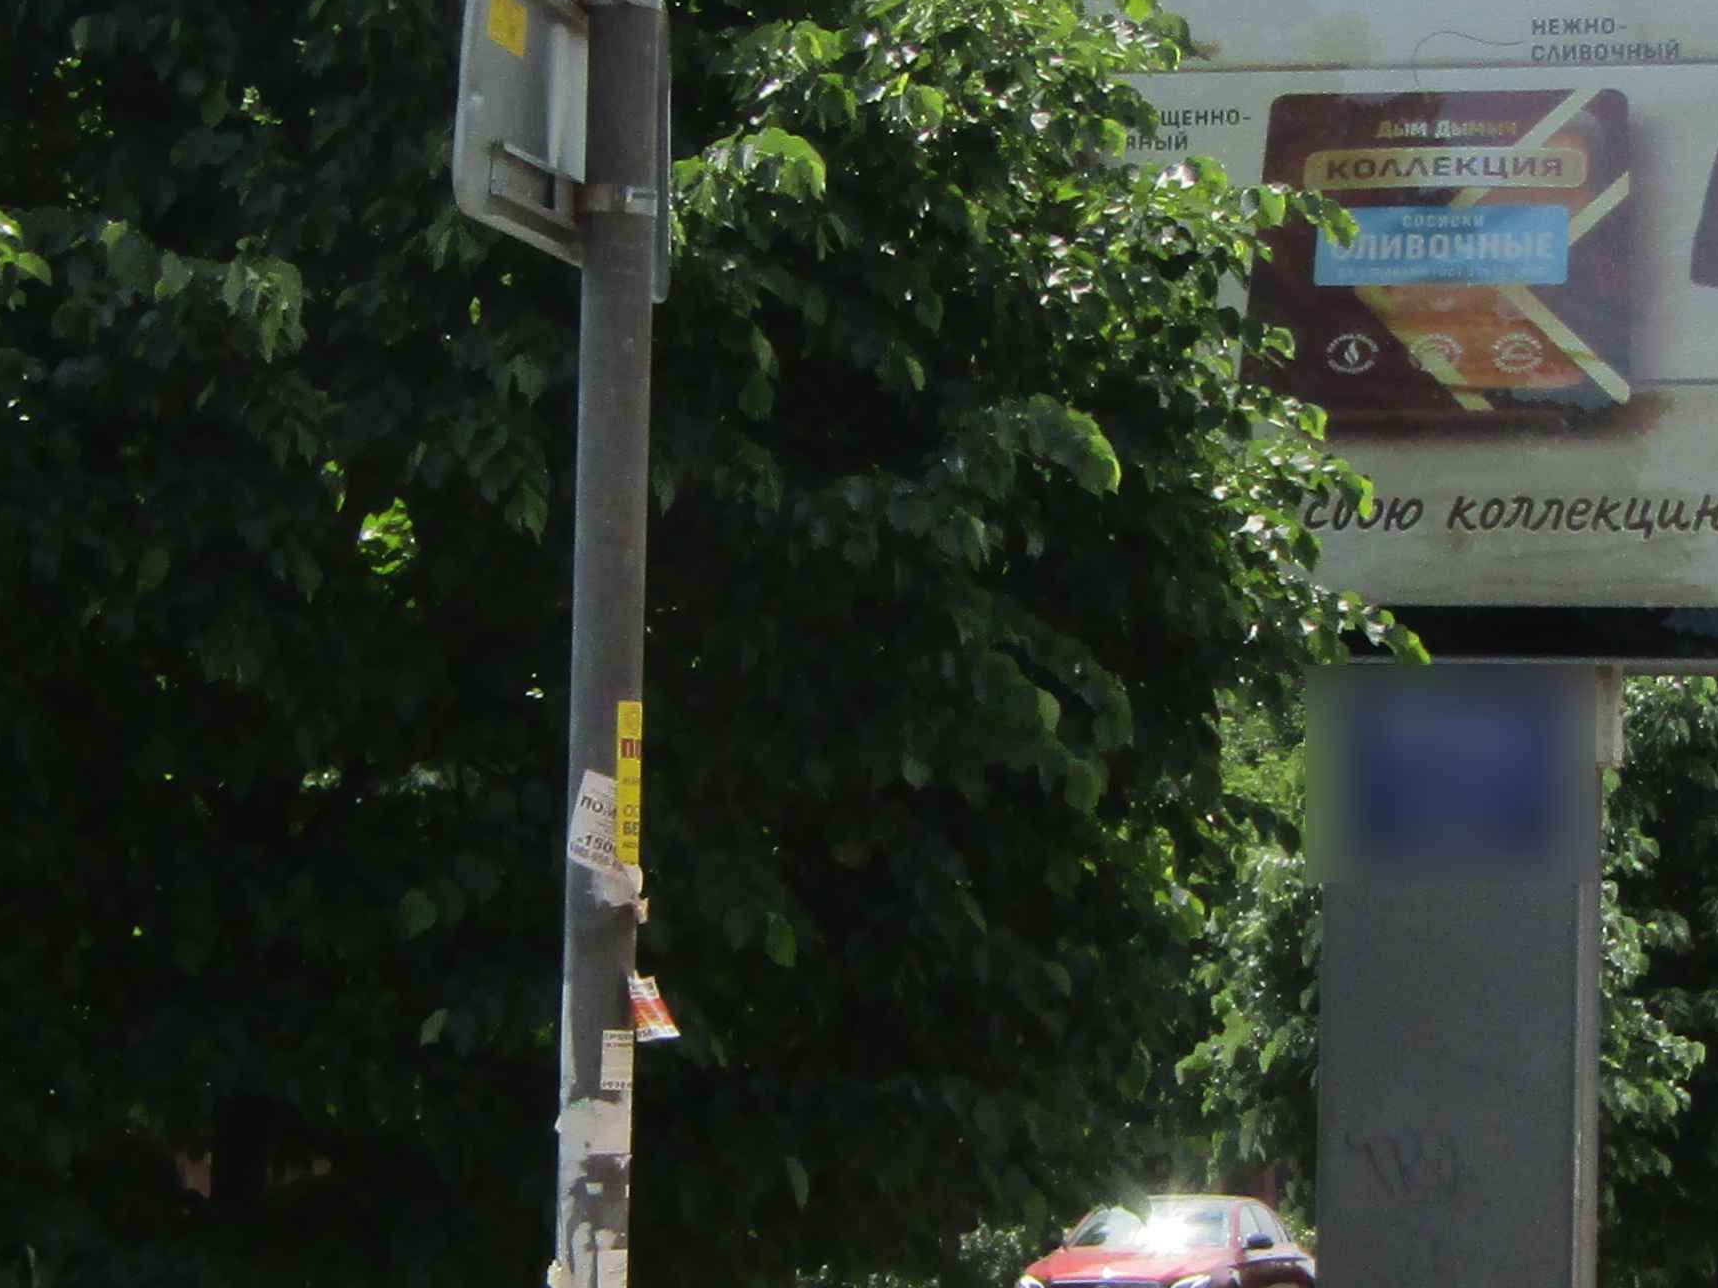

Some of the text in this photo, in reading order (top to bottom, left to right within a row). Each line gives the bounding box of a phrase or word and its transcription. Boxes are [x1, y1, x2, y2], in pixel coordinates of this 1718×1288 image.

[1531, 18, 1627, 37] НЕЖНО-
[1531, 39, 1680, 62] СЛИВОЧНЫЙ
[1161, 109, 1251, 128] ЩЕННО-
[1127, 131, 1188, 151] ЯНЫЙ
[1326, 156, 1563, 180] КОЛЛЕКЦИЯ
